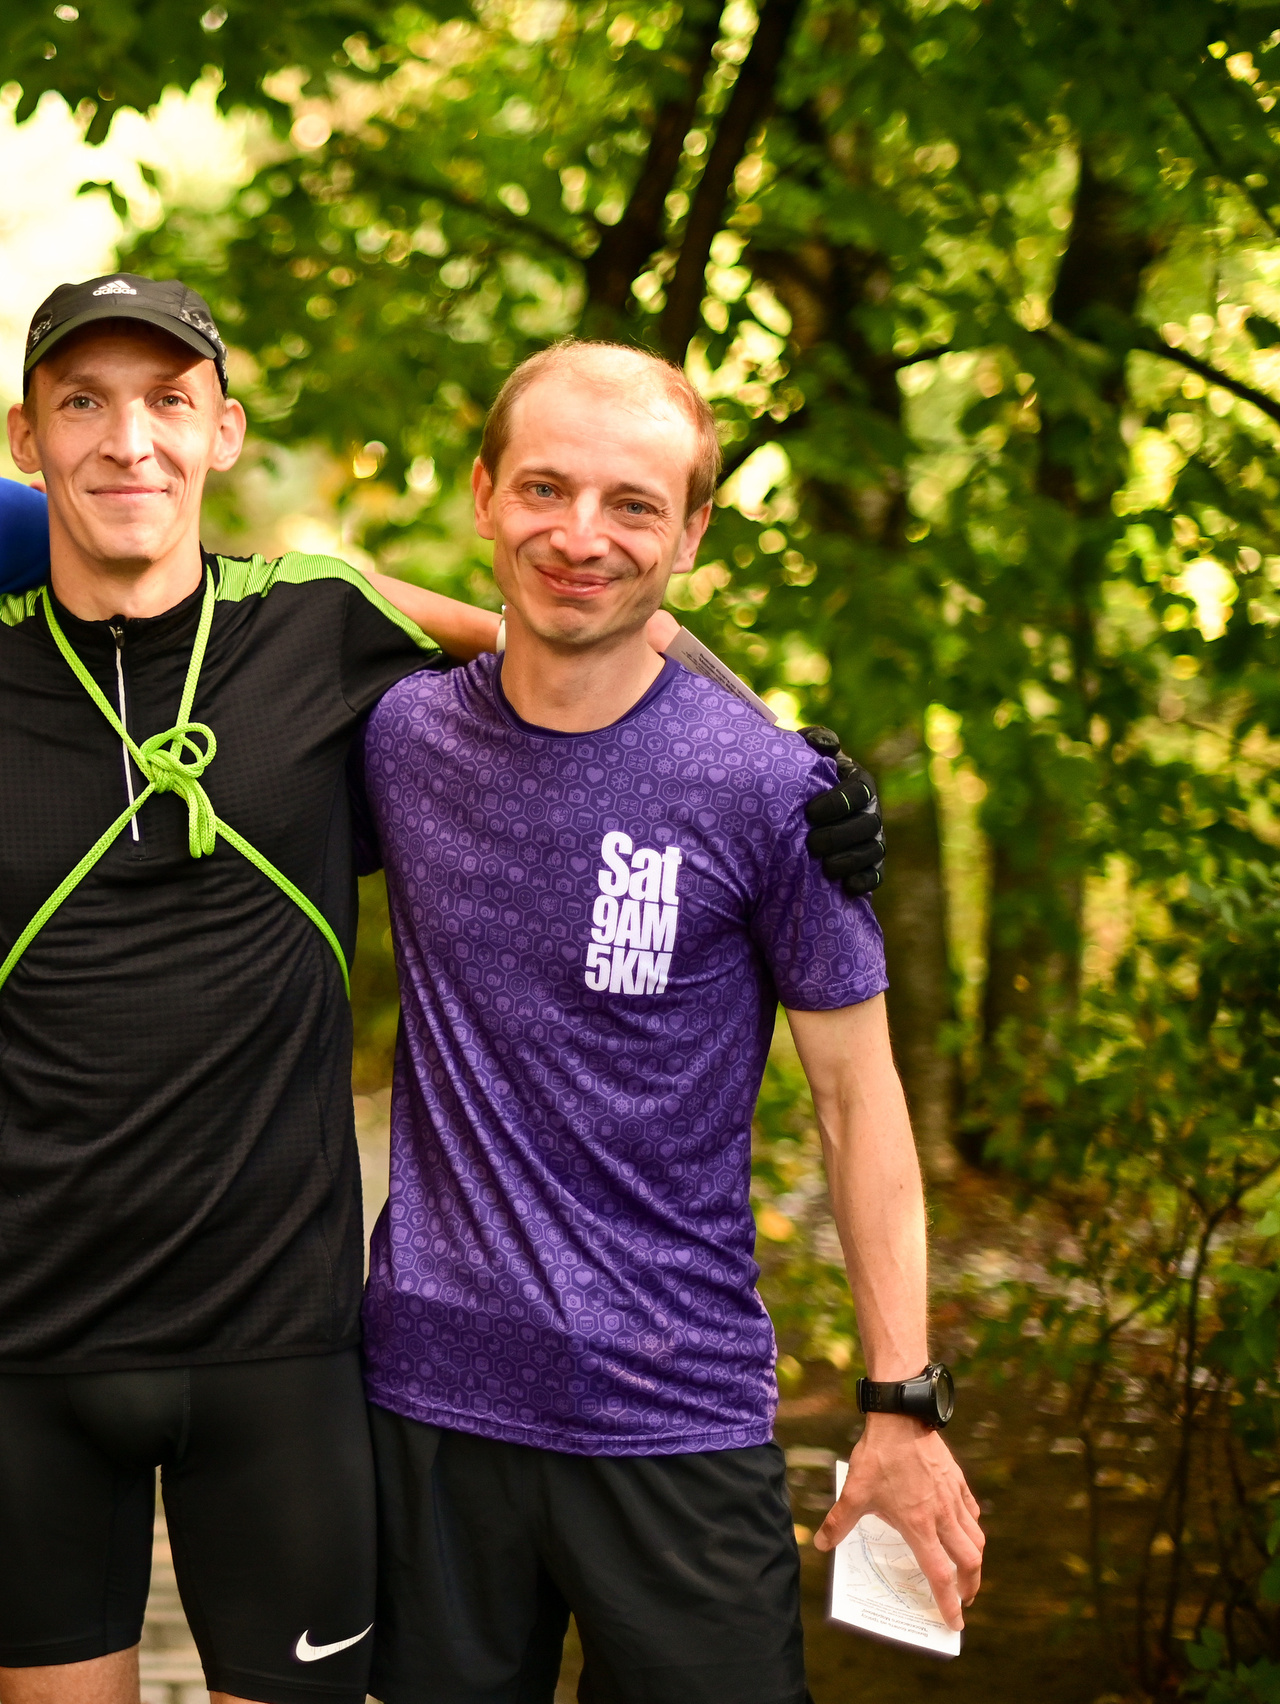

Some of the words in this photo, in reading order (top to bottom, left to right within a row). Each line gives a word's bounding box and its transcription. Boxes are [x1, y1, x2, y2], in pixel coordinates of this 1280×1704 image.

[92, 286, 137, 296] adidas
[598, 831, 683, 905] Sat
[591, 895, 679, 952] 9AM
[584, 942, 673, 995] 5KM
